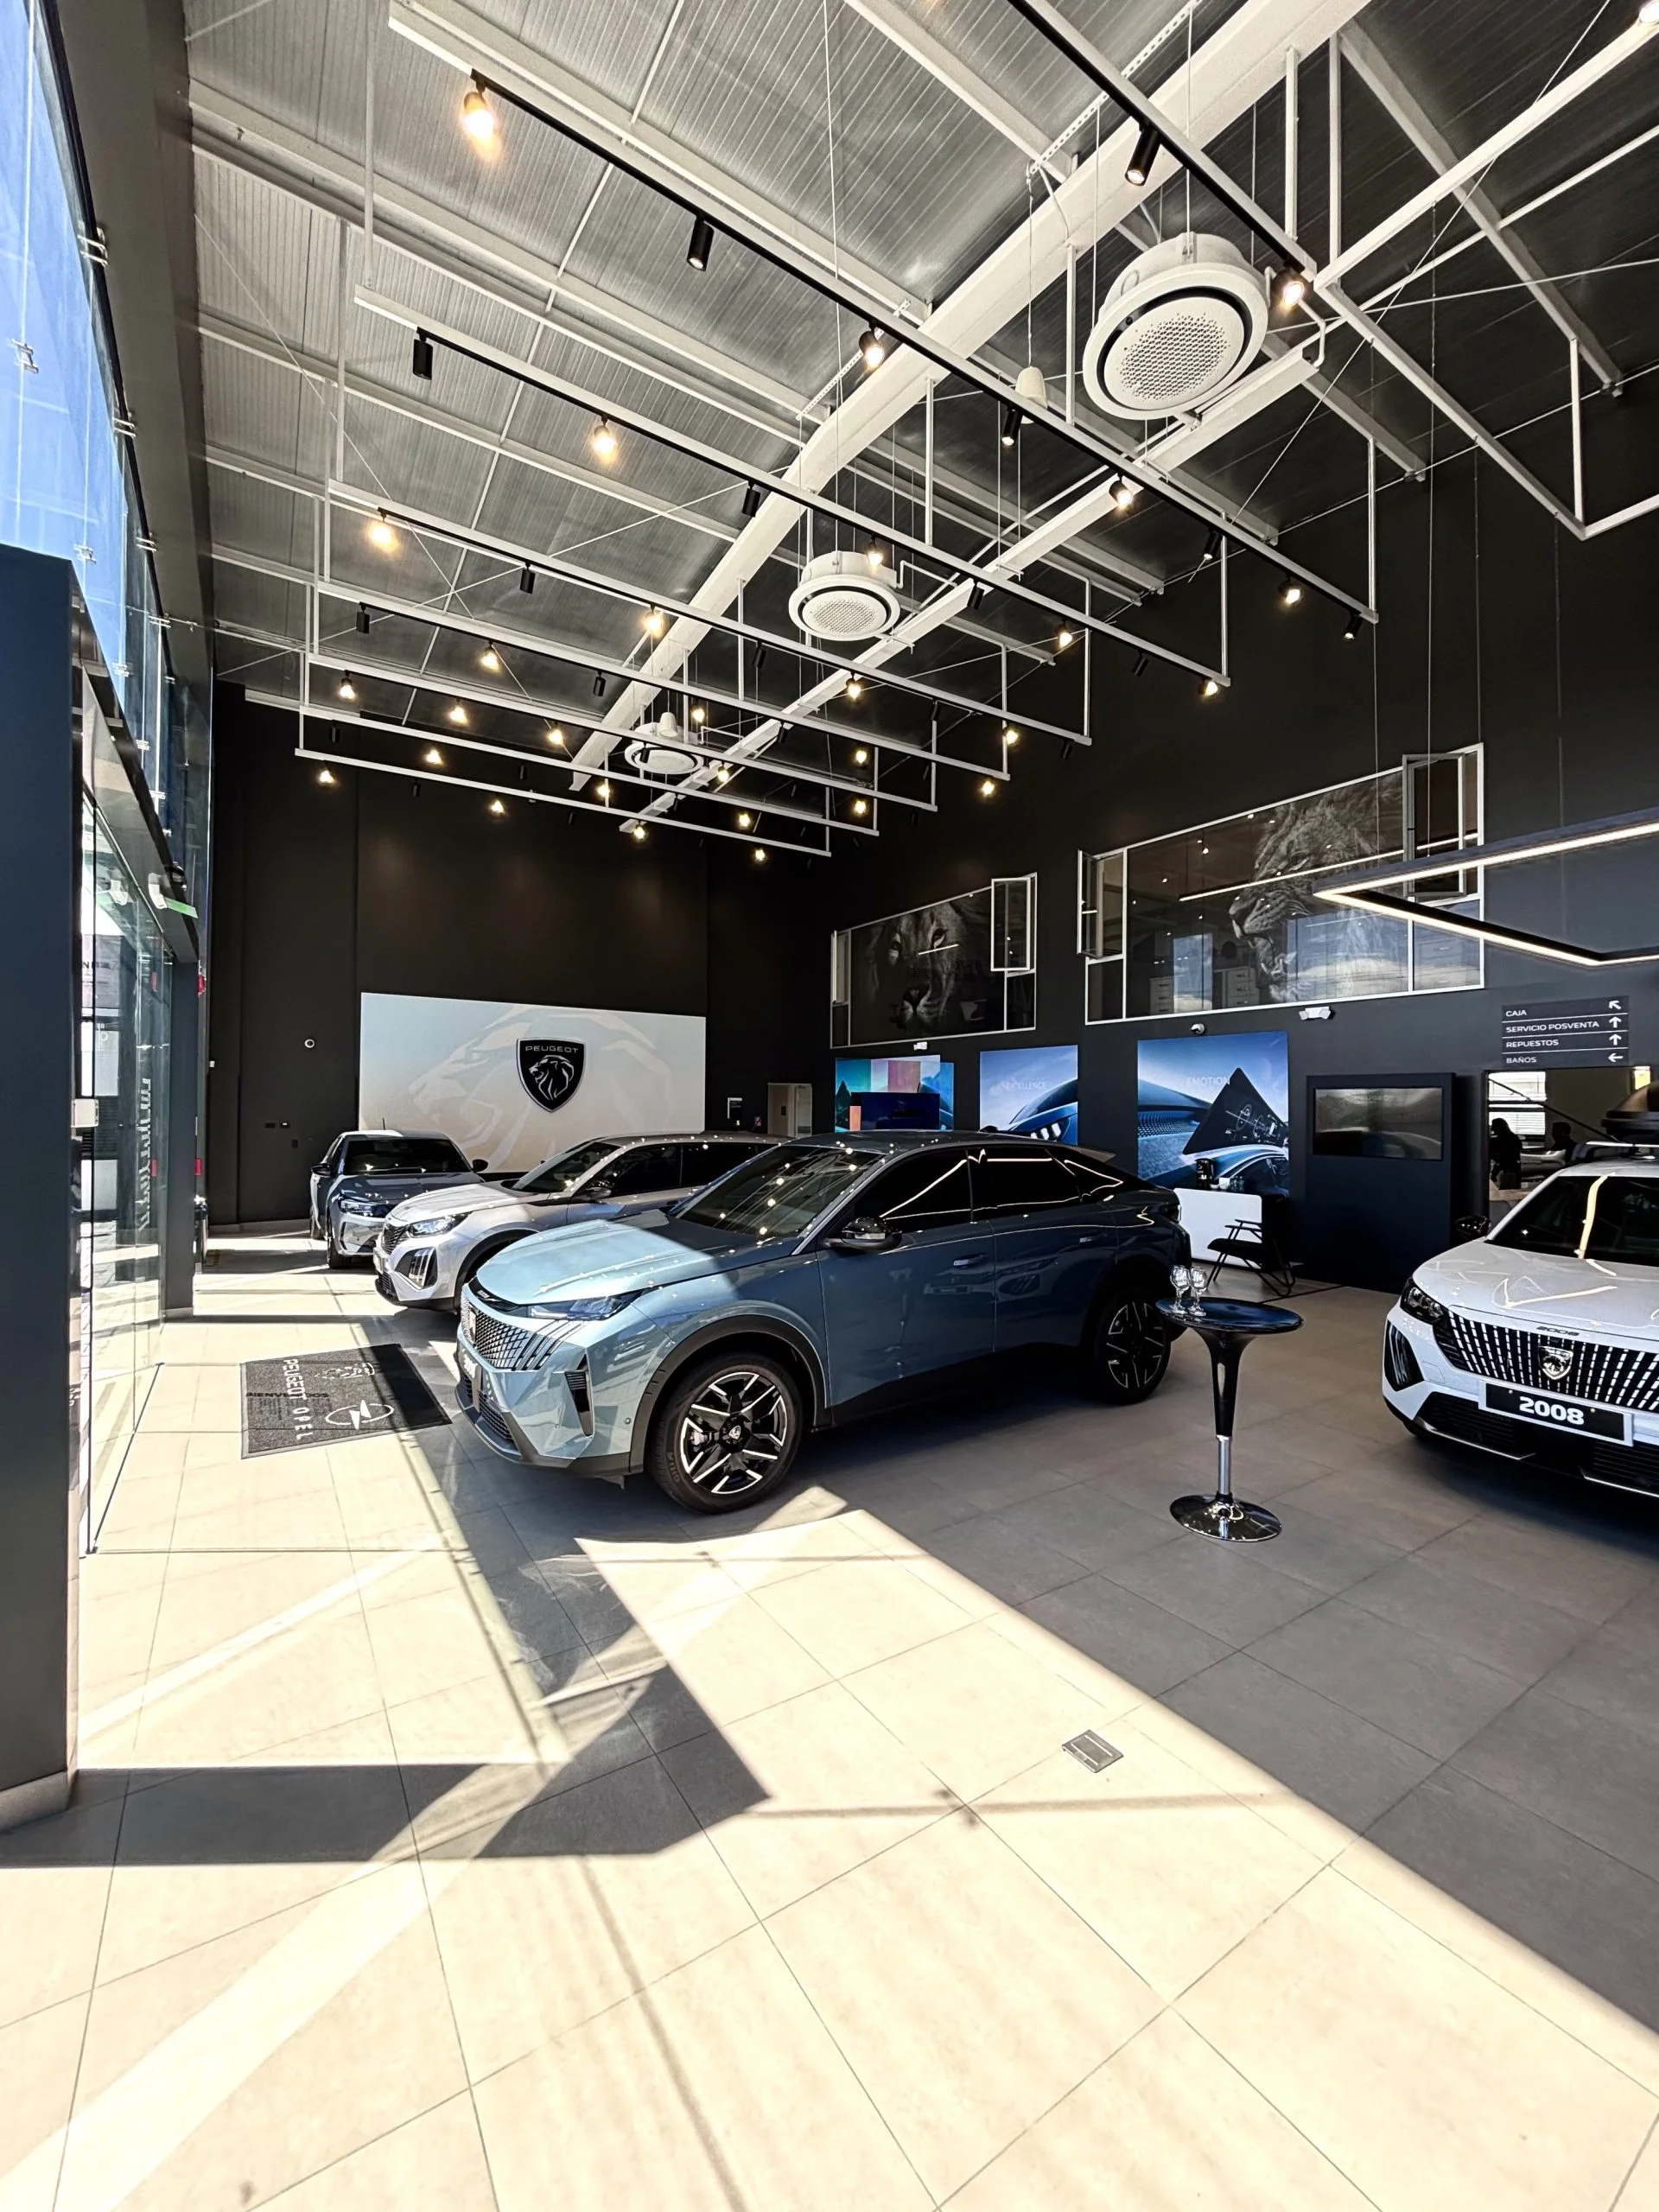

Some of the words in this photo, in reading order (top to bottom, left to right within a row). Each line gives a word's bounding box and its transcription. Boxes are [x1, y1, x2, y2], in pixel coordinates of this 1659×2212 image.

[1505, 1024, 1548, 1033] SERVICIO
[1548, 1020, 1600, 1031] POSVENTA
[524, 1045, 579, 1053] PEUGEOT
[1506, 1039, 1560, 1048] REPUESTOS
[283, 1358, 307, 1400] PEUGEOT
[1519, 1395, 1585, 1426] 2008
[293, 1407, 314, 1440] OPEL
